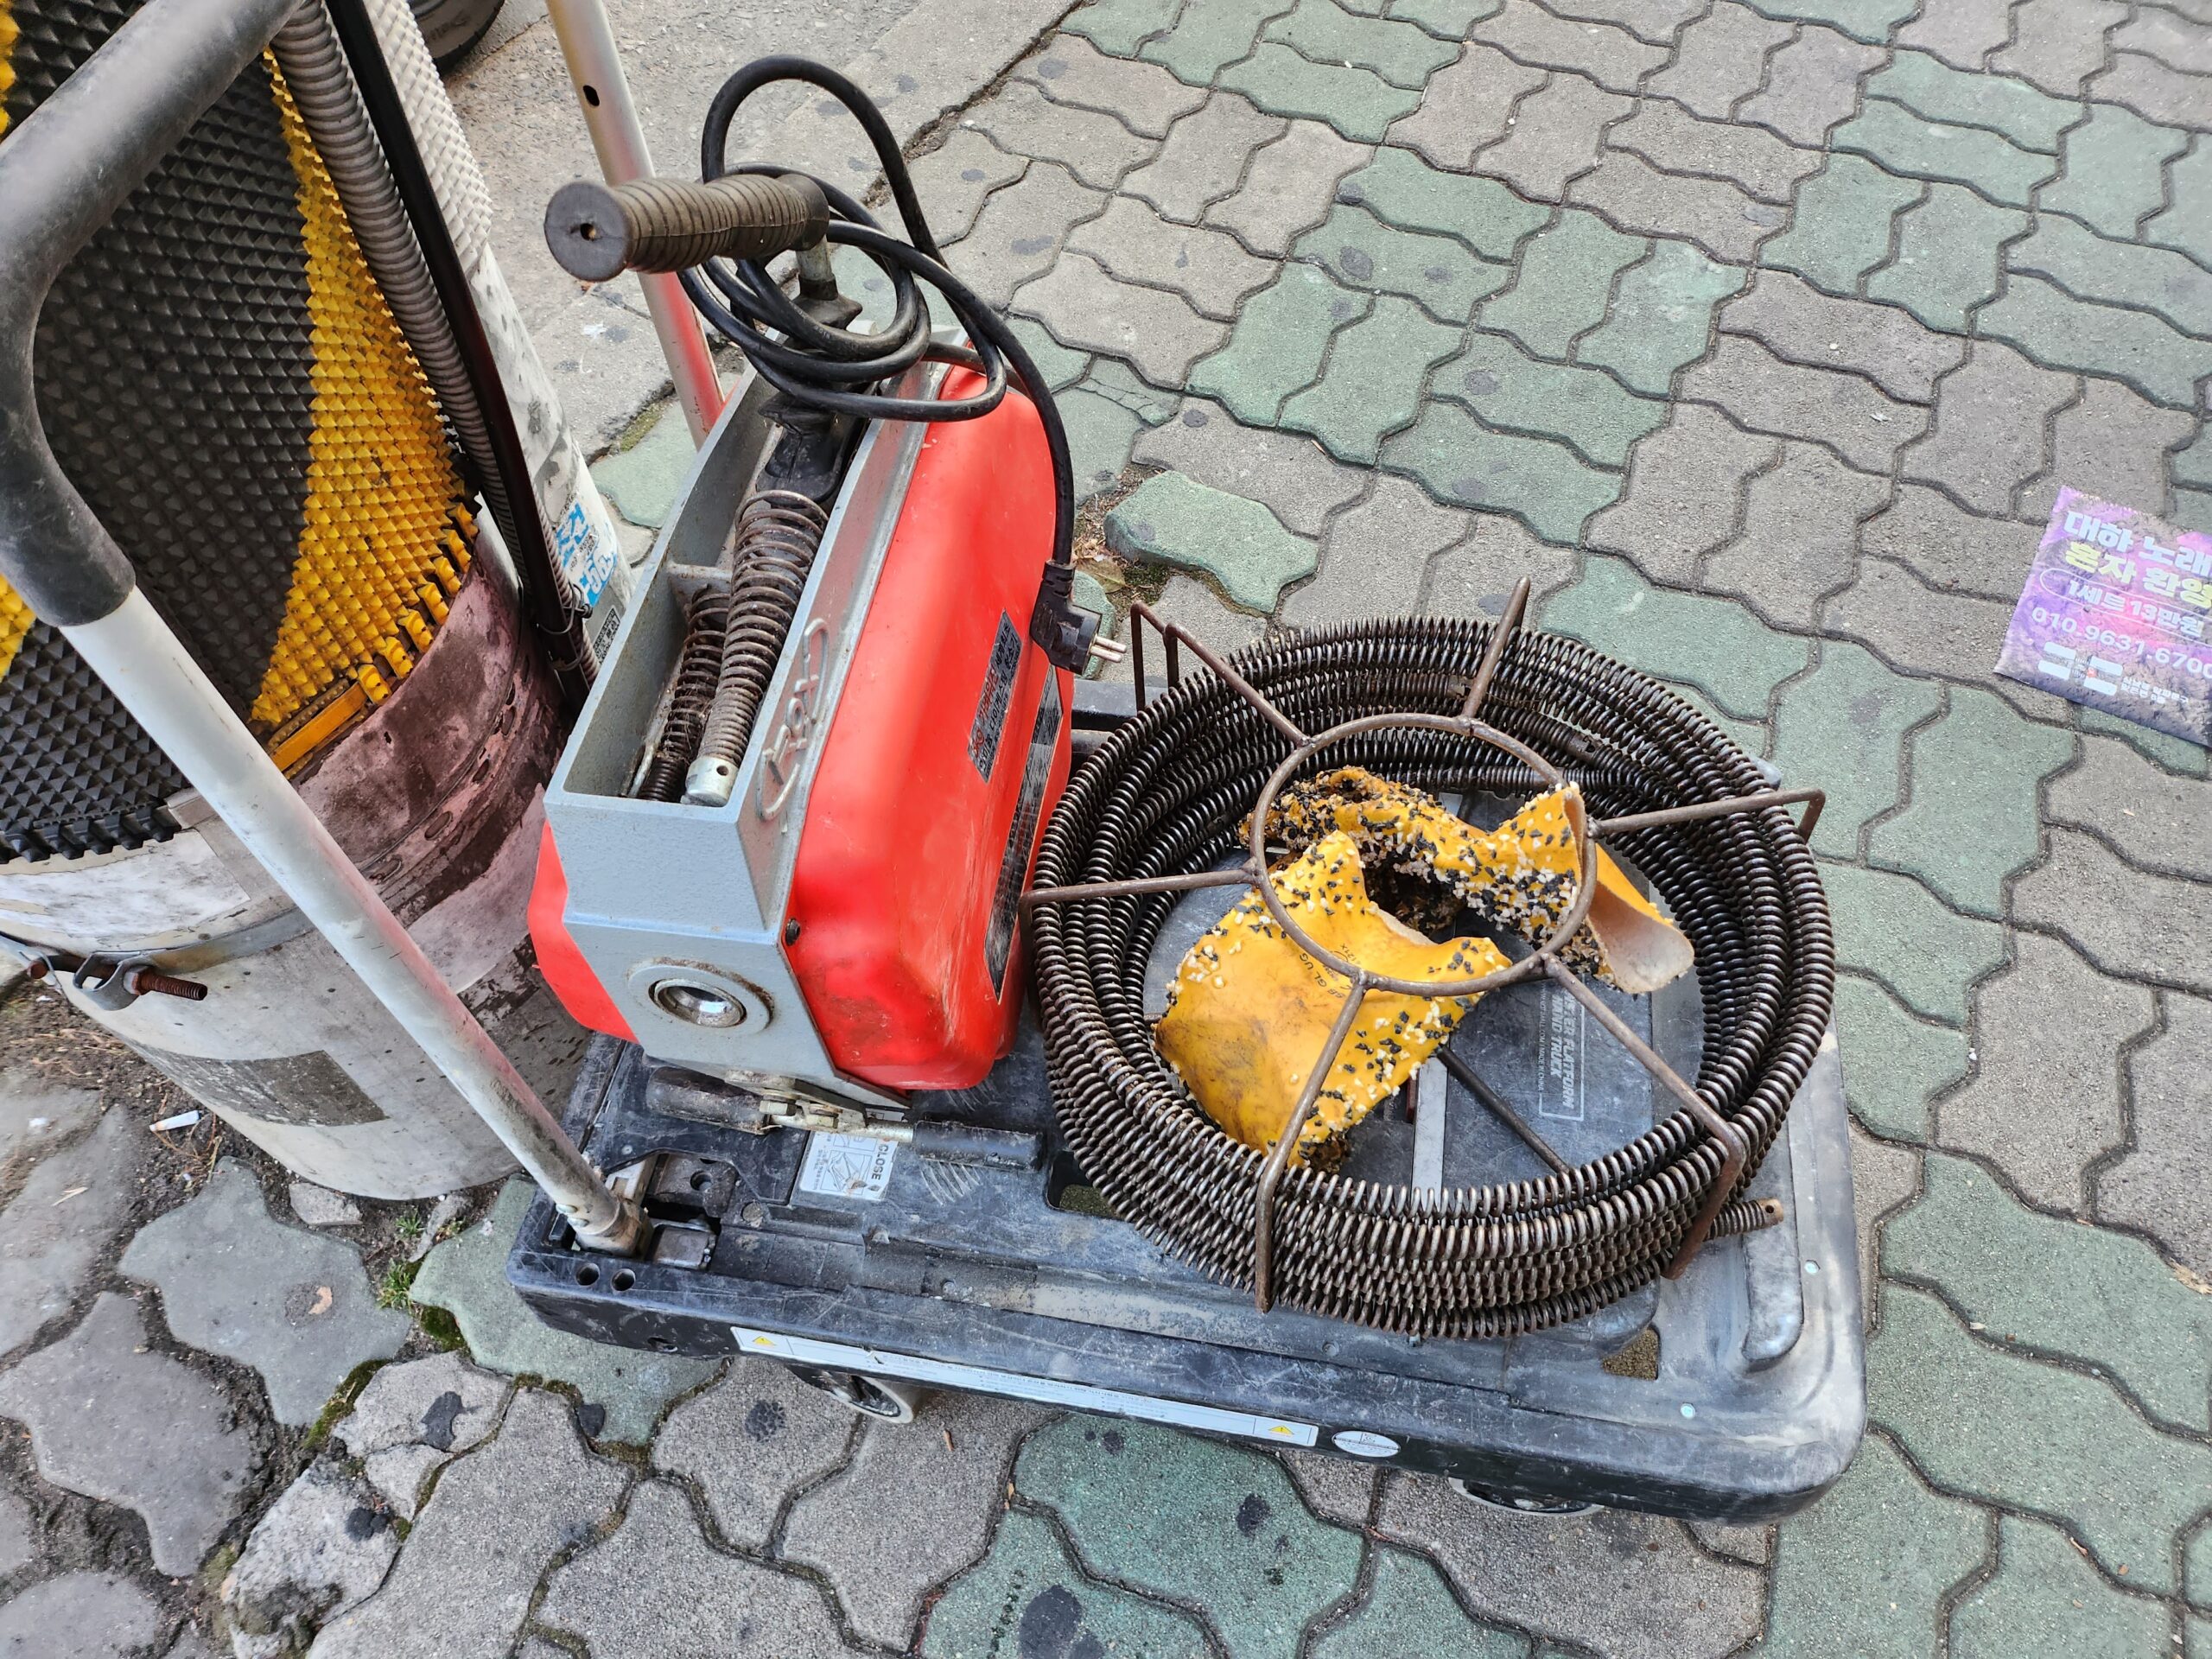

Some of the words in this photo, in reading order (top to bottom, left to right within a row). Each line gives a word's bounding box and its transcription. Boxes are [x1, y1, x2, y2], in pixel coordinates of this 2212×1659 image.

[2063, 511, 2133, 552] 대하
[2065, 541, 2137, 584] 혼자
[1551, 994, 1564, 1033] HAND
[1550, 1036, 1562, 1079] TRUCK
[1562, 1037, 1575, 1109] FLATFORM
[871, 1143, 889, 1181] CLOSE
